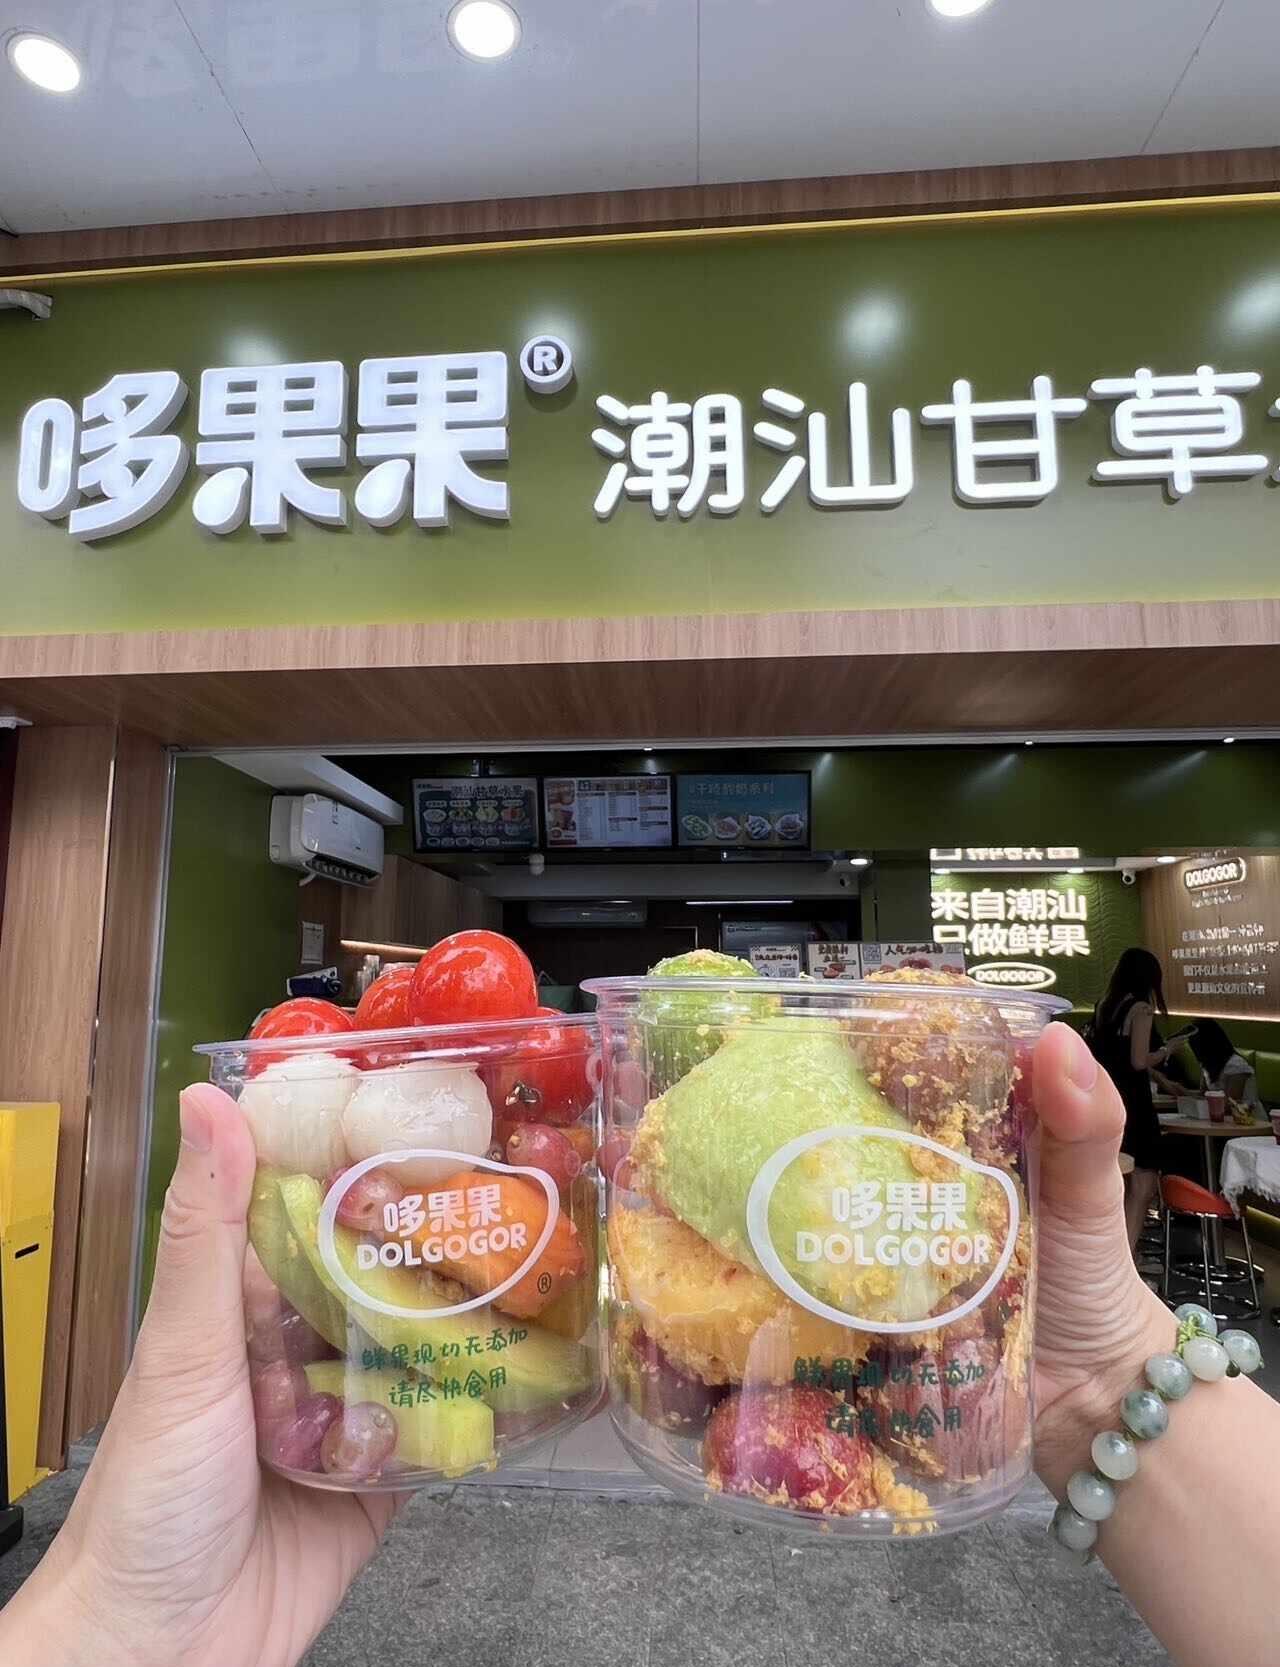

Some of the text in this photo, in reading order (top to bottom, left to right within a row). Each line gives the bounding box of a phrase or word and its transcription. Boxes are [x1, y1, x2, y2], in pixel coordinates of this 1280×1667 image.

[18, 350, 511, 542] 哆果果
[592, 364, 1280, 518] 潮汕甘草
[1185, 861, 1239, 888] DOLGOGOR
[931, 887, 1088, 921] 来自潮汕
[974, 969, 1047, 983] DOLGOGOR
[383, 1183, 502, 1238] 哆果果
[832, 1180, 968, 1232] 哆果果
[356, 1222, 528, 1271] DOLGOGOR
[795, 1230, 992, 1267] DOLGOGOR
[360, 1327, 530, 1371] 鲜果现切无添加
[389, 1365, 507, 1408] 请尽快食用
